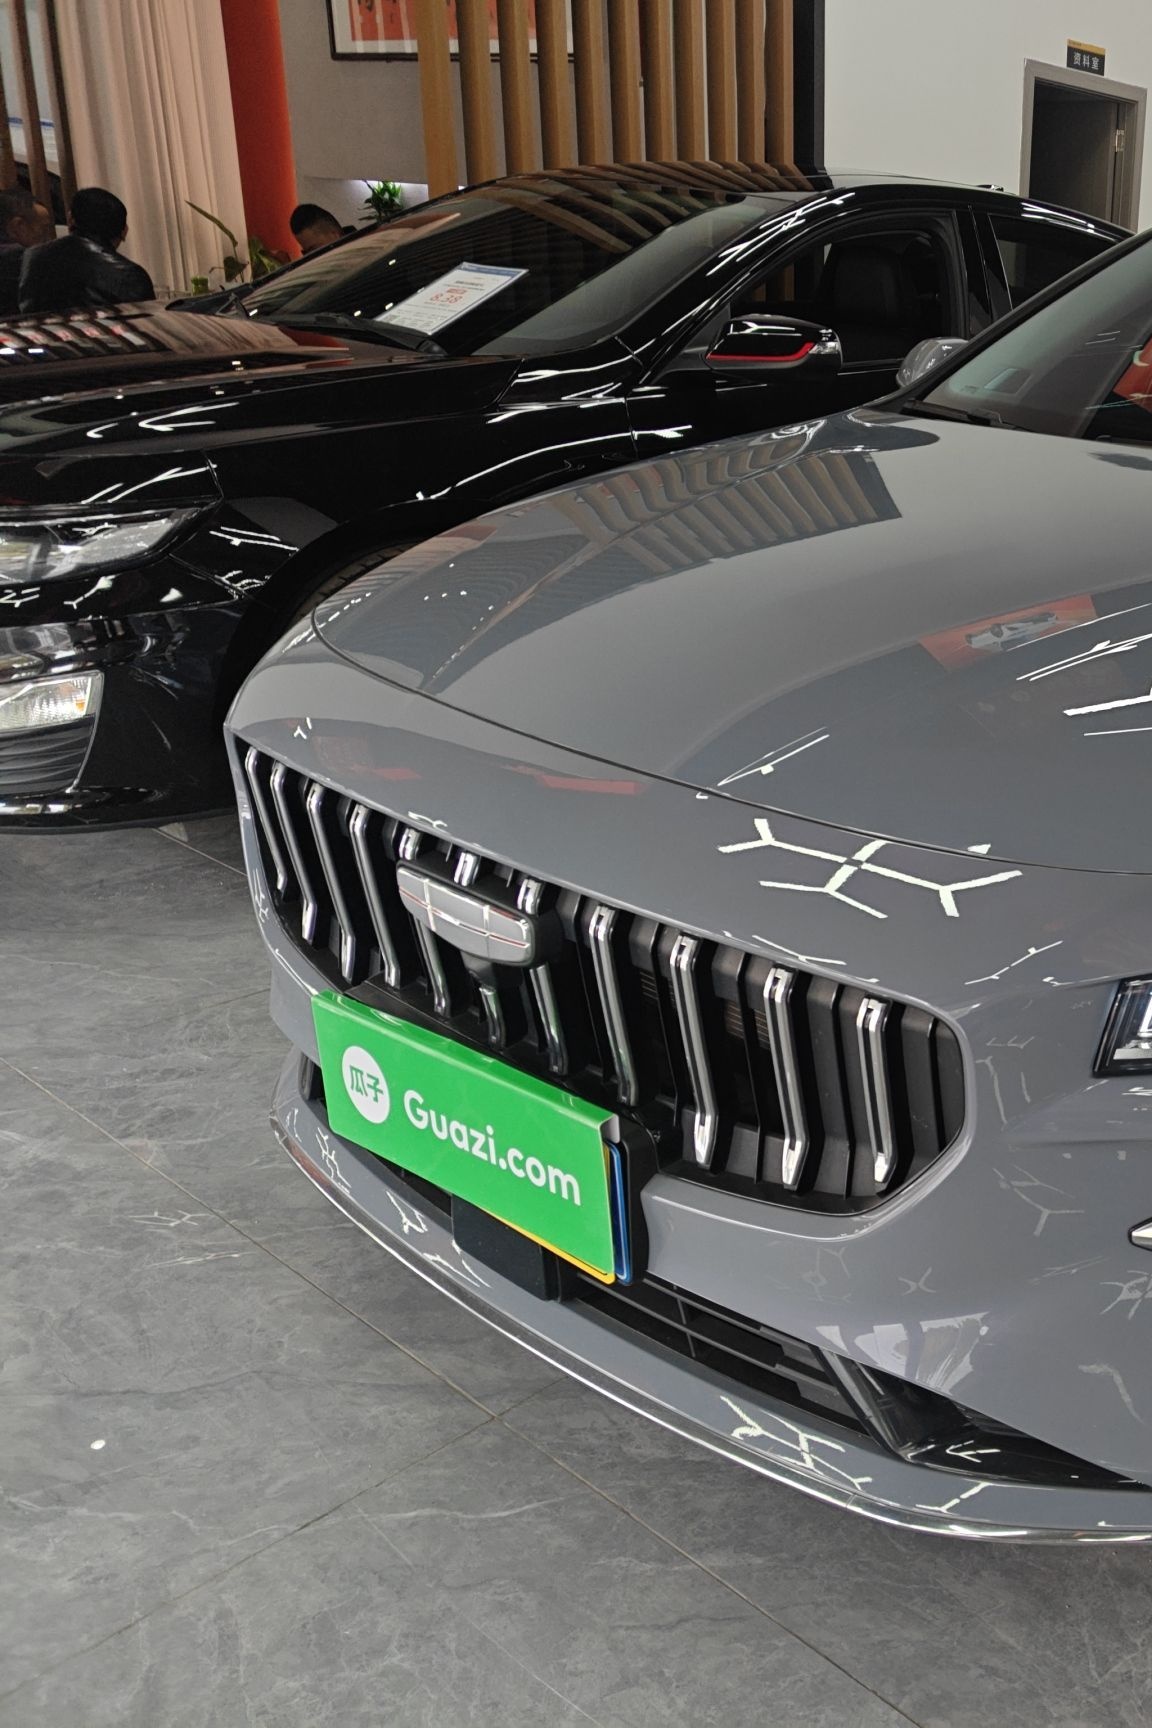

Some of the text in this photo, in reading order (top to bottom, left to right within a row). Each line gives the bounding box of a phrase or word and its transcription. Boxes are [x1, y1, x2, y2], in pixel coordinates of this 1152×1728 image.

[1073, 51, 1099, 70] 资料室
[349, 1065, 384, 1103] 瓜子
[404, 1090, 581, 1206] Guazi.com
